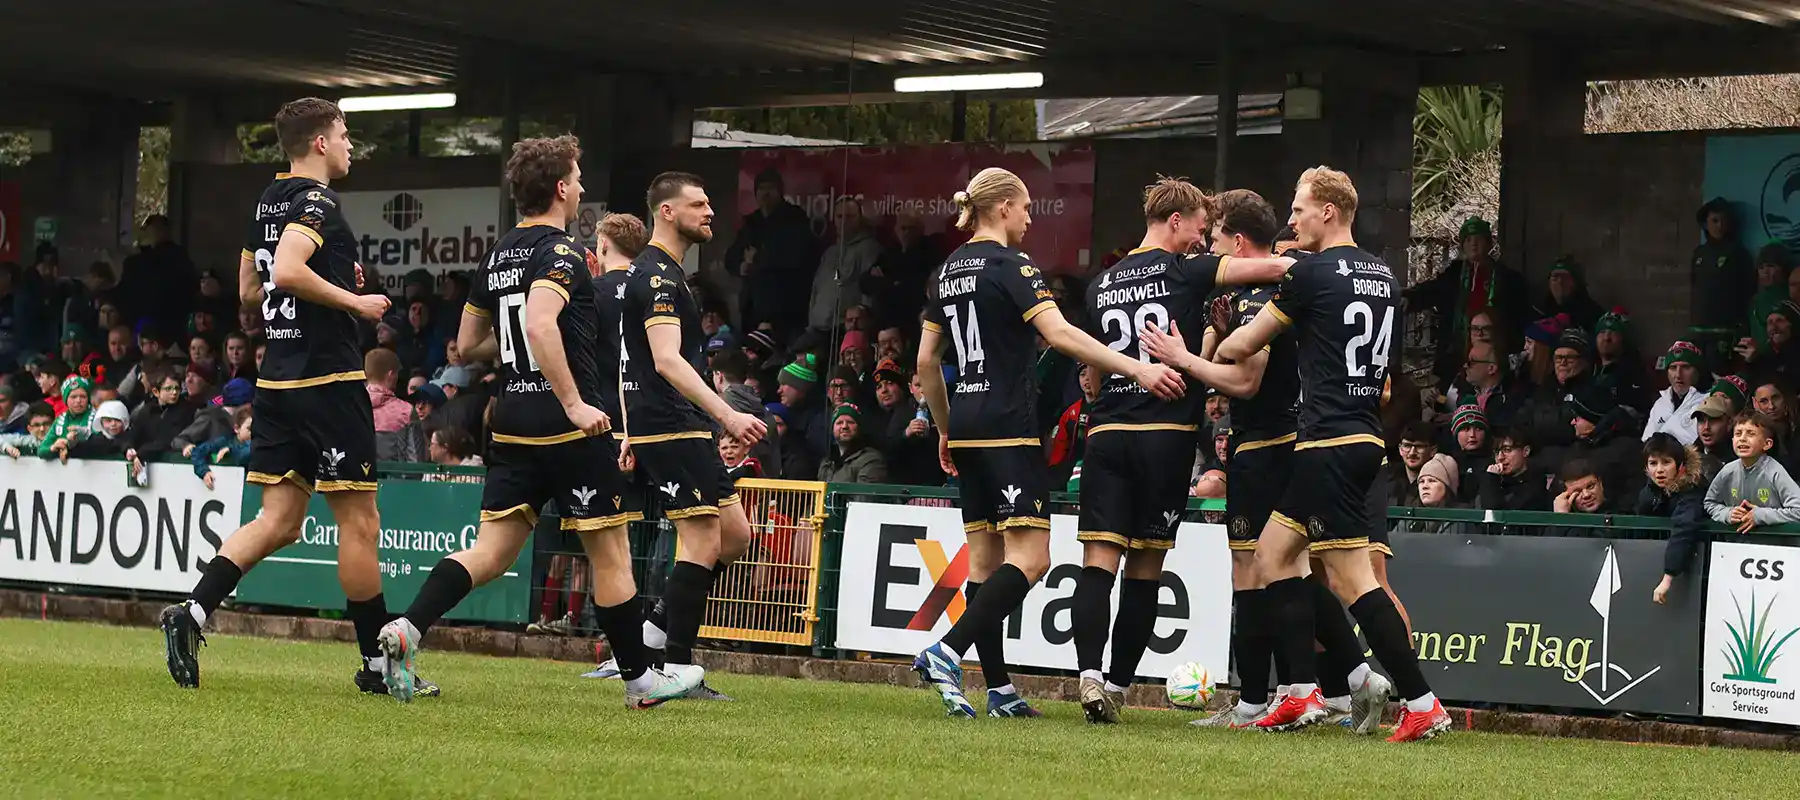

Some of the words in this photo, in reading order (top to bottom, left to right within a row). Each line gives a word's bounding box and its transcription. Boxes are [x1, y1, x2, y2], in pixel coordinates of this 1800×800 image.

[1029, 196, 1064, 216] ntre
[355, 225, 495, 266] terkabi
[1115, 263, 1167, 279] DUALCORE
[1097, 280, 1170, 309] BROOKWELL
[1352, 278, 1391, 299] BORDEN
[499, 292, 540, 374] 47
[943, 300, 985, 377] 14
[1343, 301, 1395, 379] 24
[1740, 558, 1784, 581] CSS
[1499, 622, 1593, 683] Flag
[1710, 681, 1730, 694] Cork
[1731, 684, 1795, 701] Sportsground
[1732, 700, 1769, 715] Services
